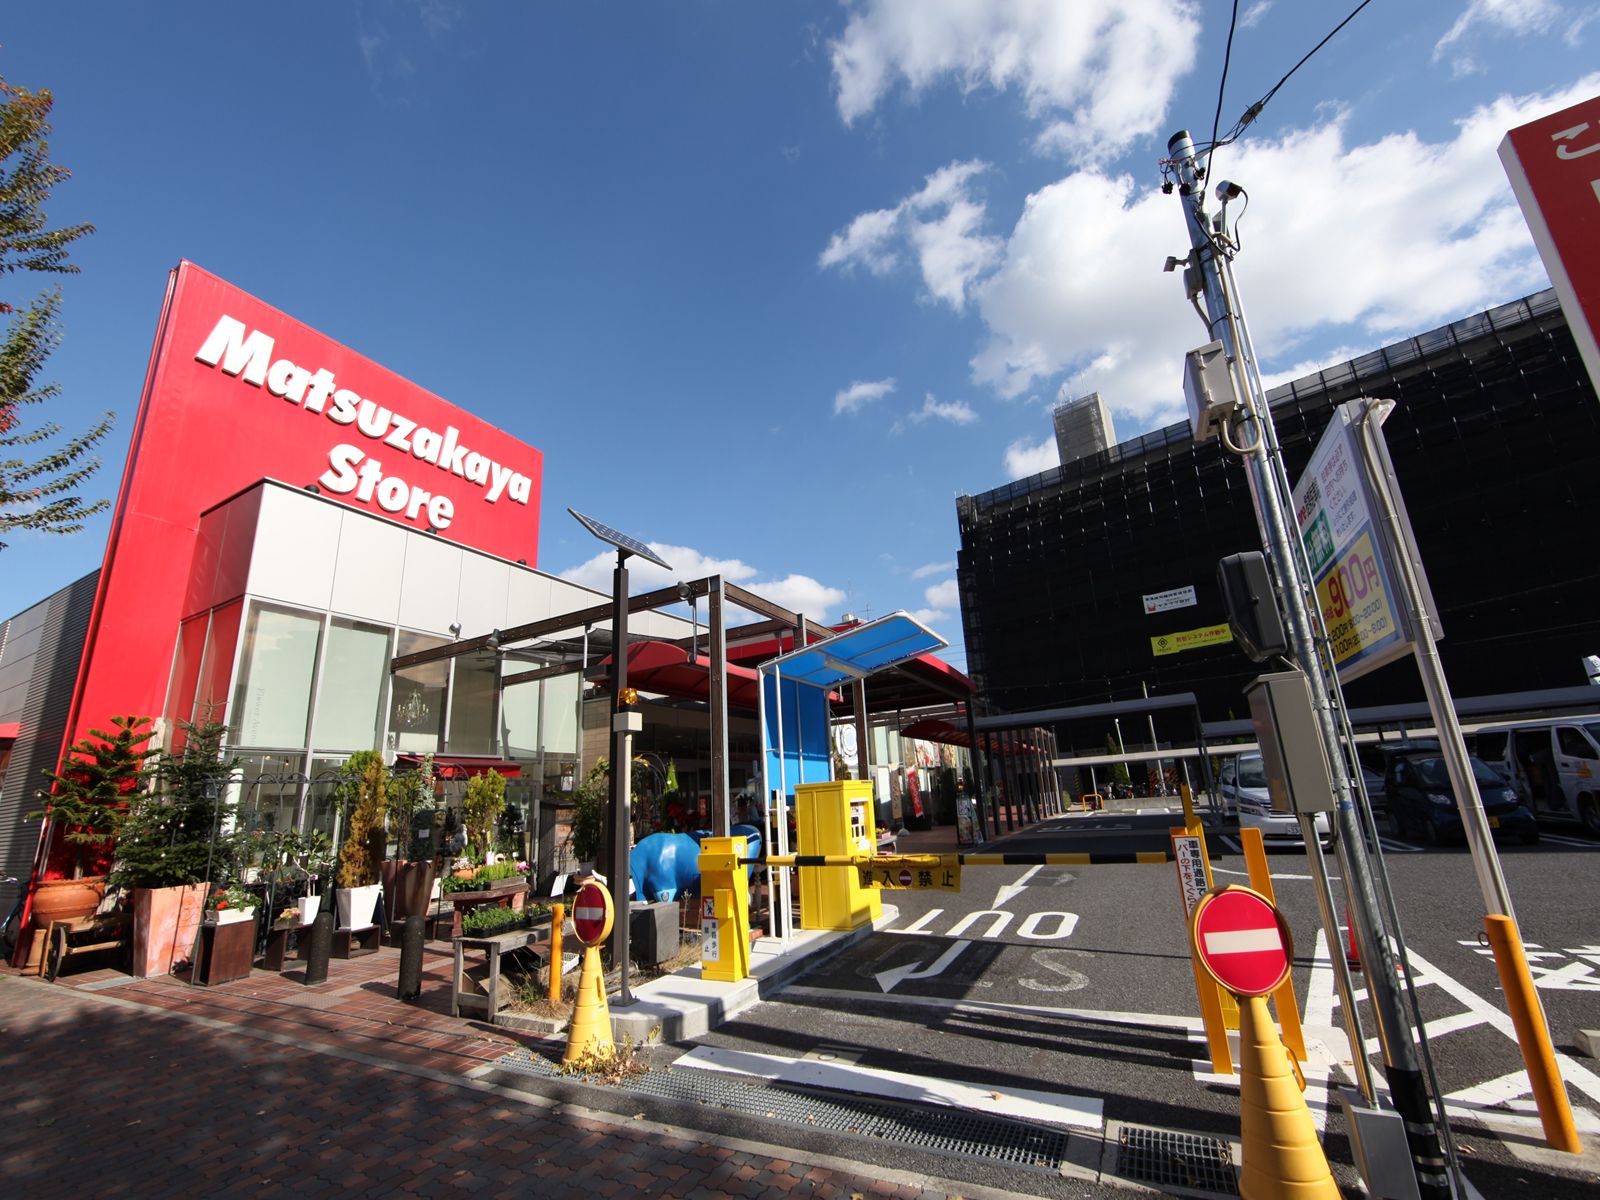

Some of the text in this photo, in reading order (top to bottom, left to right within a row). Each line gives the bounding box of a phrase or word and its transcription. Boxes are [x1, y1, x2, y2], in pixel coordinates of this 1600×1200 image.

[195, 314, 532, 504] Matsuzakaya
[319, 443, 454, 530] Store
[884, 908, 1080, 940] OUT
